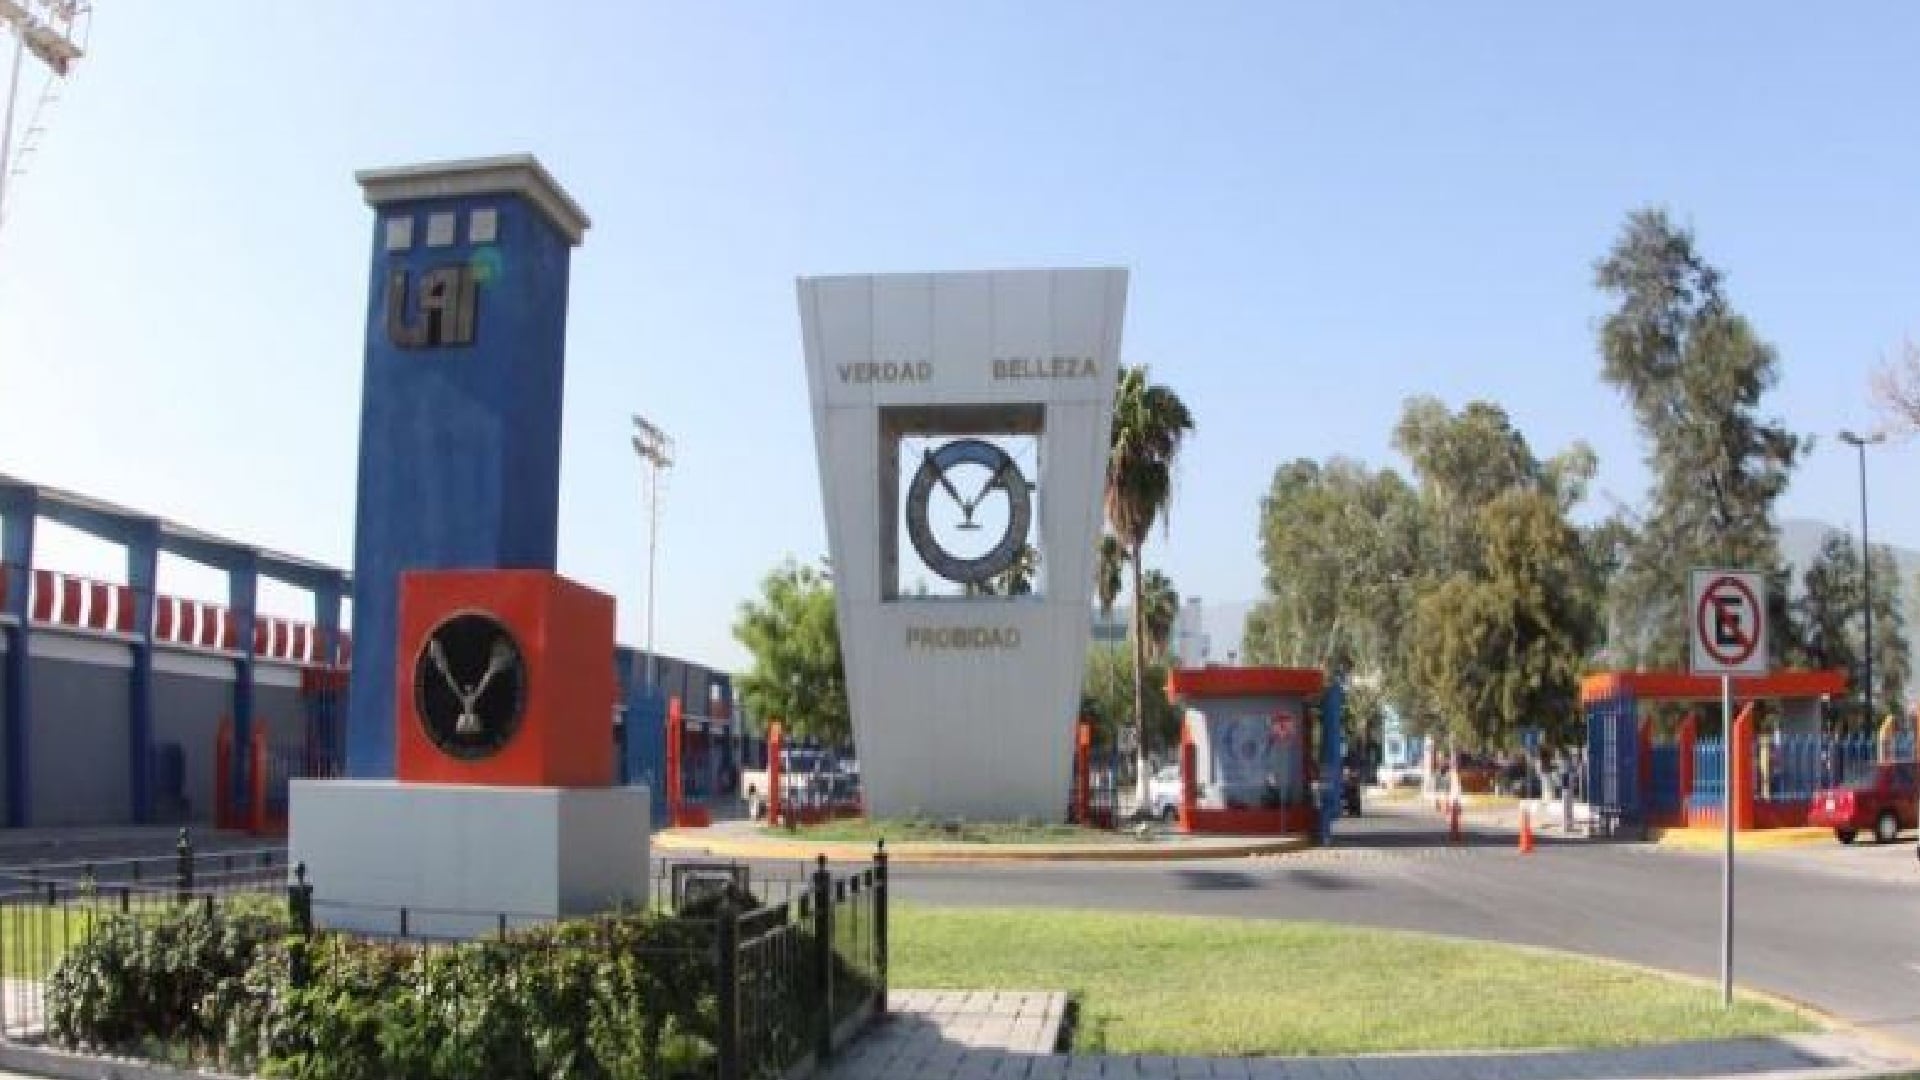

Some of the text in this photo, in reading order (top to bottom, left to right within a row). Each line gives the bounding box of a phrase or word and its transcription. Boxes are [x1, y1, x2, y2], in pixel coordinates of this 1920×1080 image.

[838, 361, 933, 384] VERDAD
[992, 357, 1098, 380] BELLEZA
[1715, 596, 1742, 645] E
[905, 626, 1021, 649] PROBIDAD
